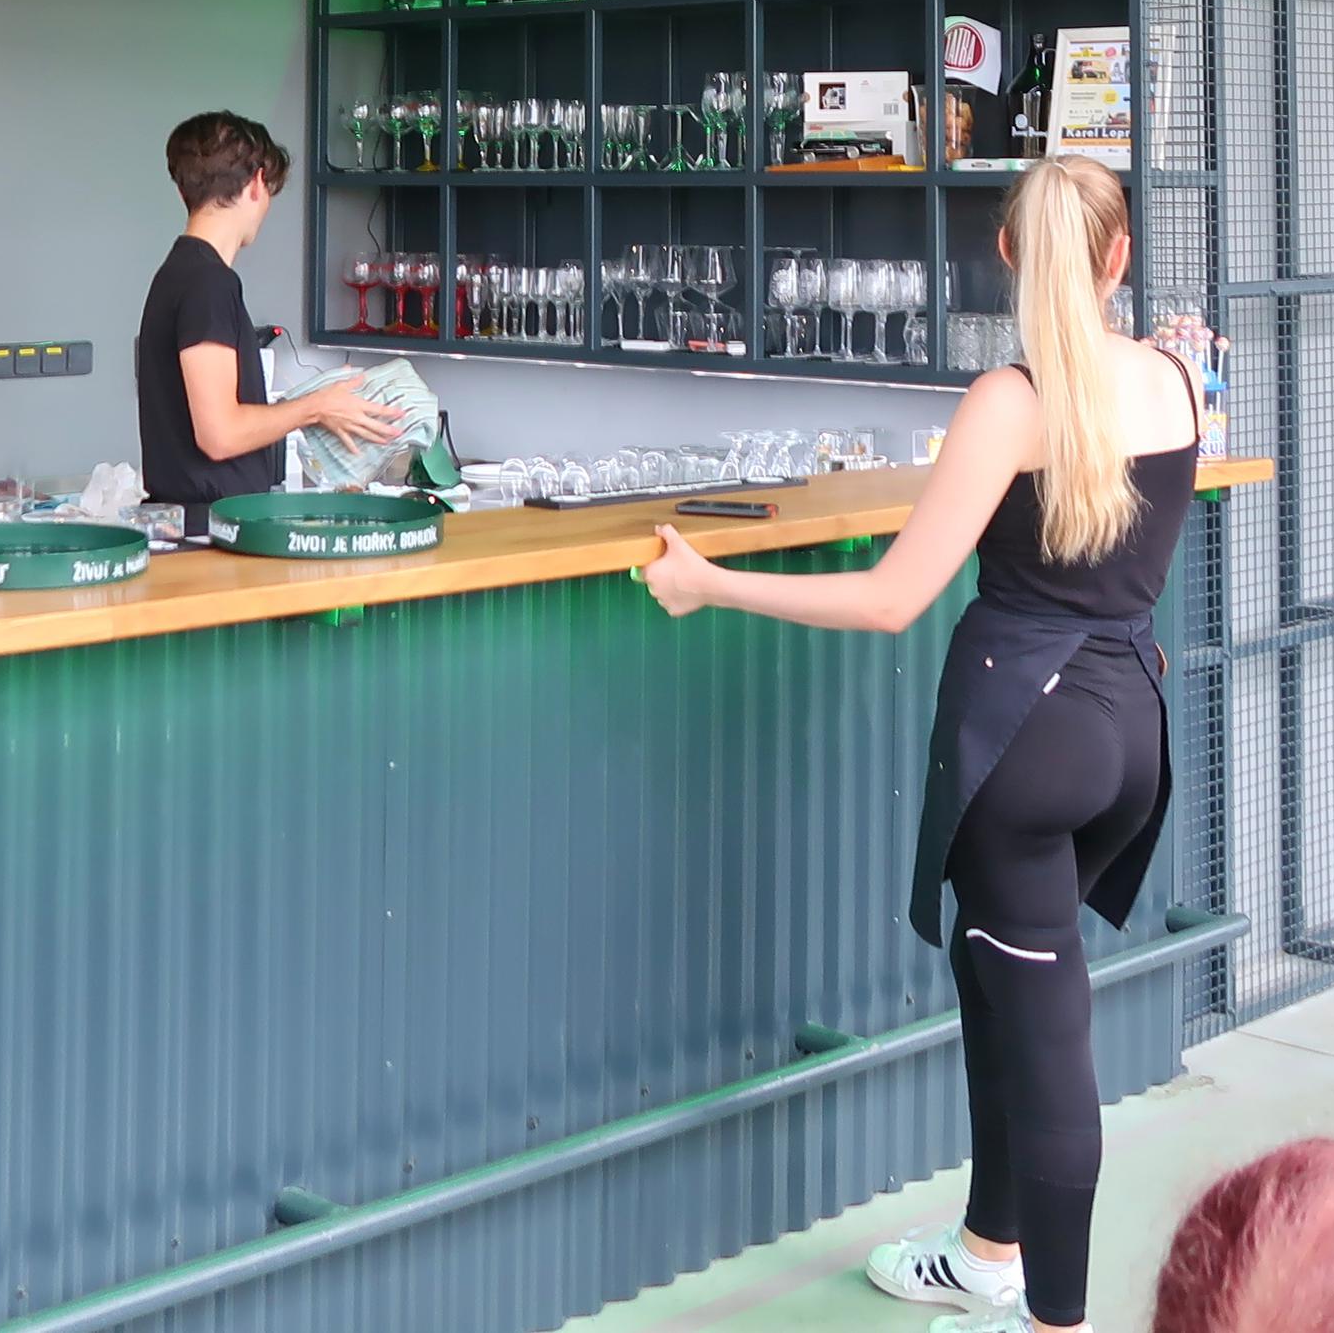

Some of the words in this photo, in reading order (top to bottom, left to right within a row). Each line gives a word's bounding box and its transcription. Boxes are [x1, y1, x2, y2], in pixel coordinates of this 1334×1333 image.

[1067, 128, 1098, 138] Karel
[1102, 128, 1131, 140] Lopr
[332, 535, 348, 554] JE
